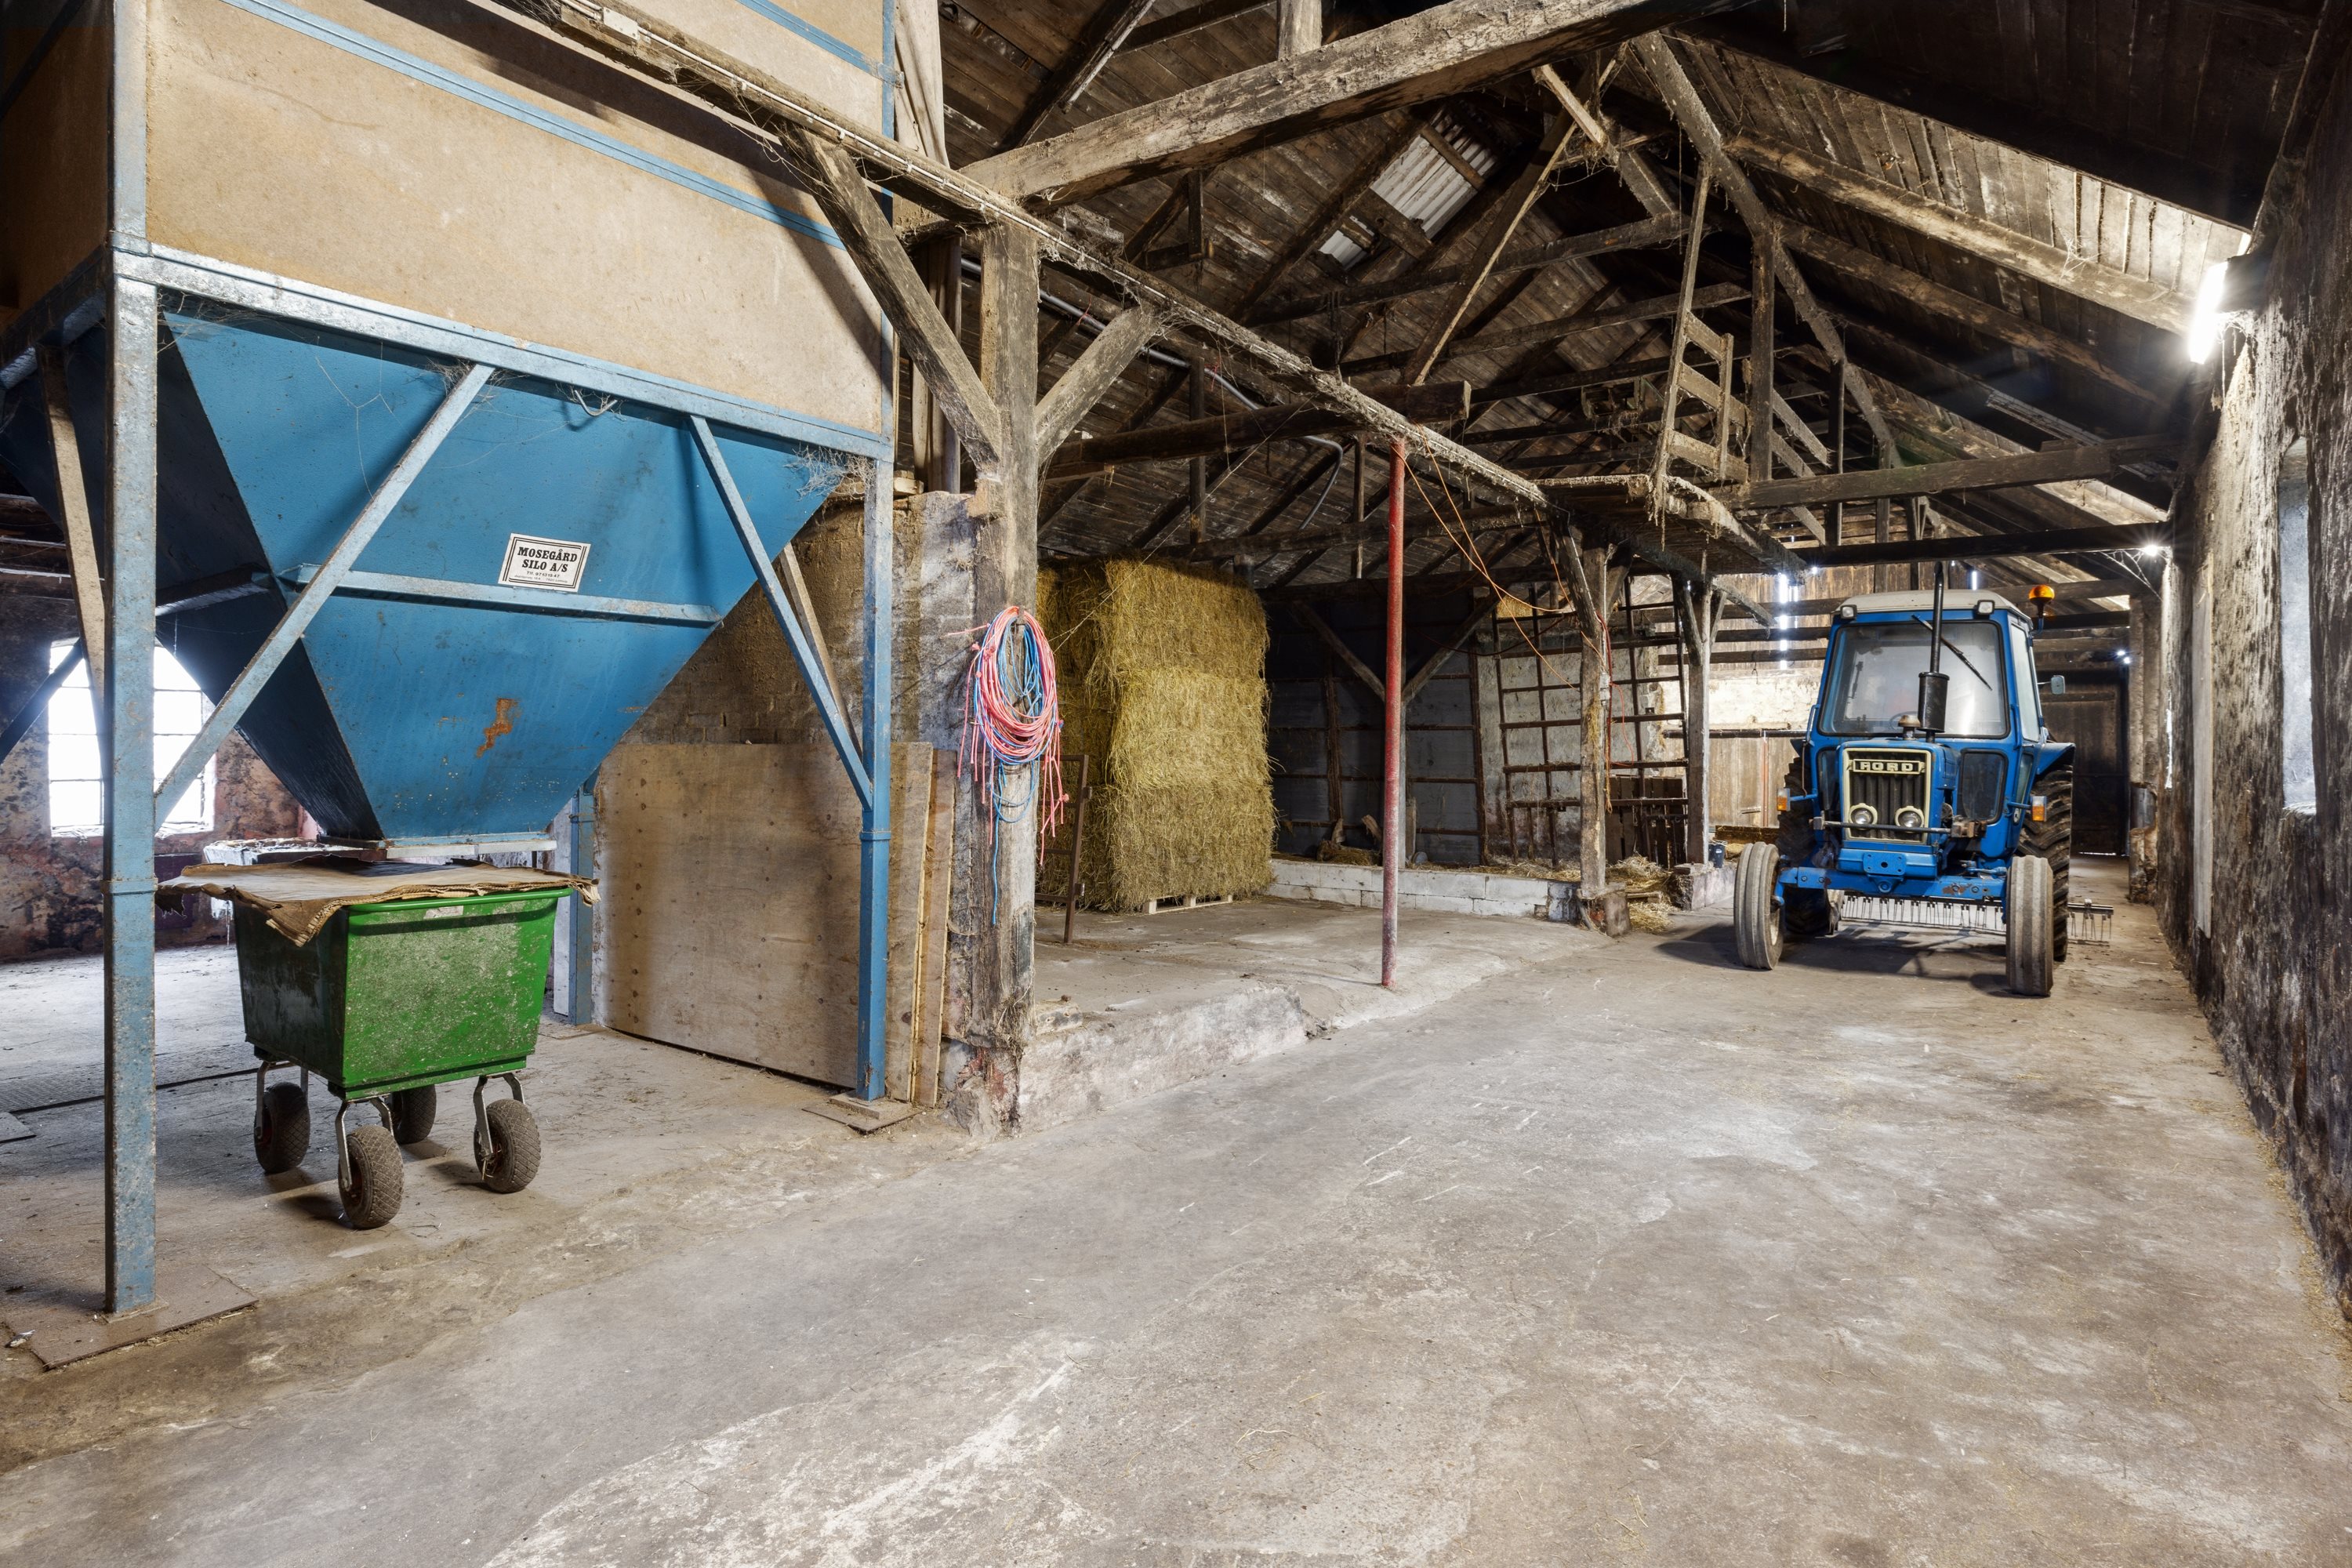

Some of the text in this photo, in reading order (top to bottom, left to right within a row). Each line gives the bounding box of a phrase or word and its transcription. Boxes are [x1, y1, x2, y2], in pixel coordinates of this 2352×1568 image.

[517, 546, 578, 562] MOSEGÅRD
[521, 559, 568, 572] SILO A/S
